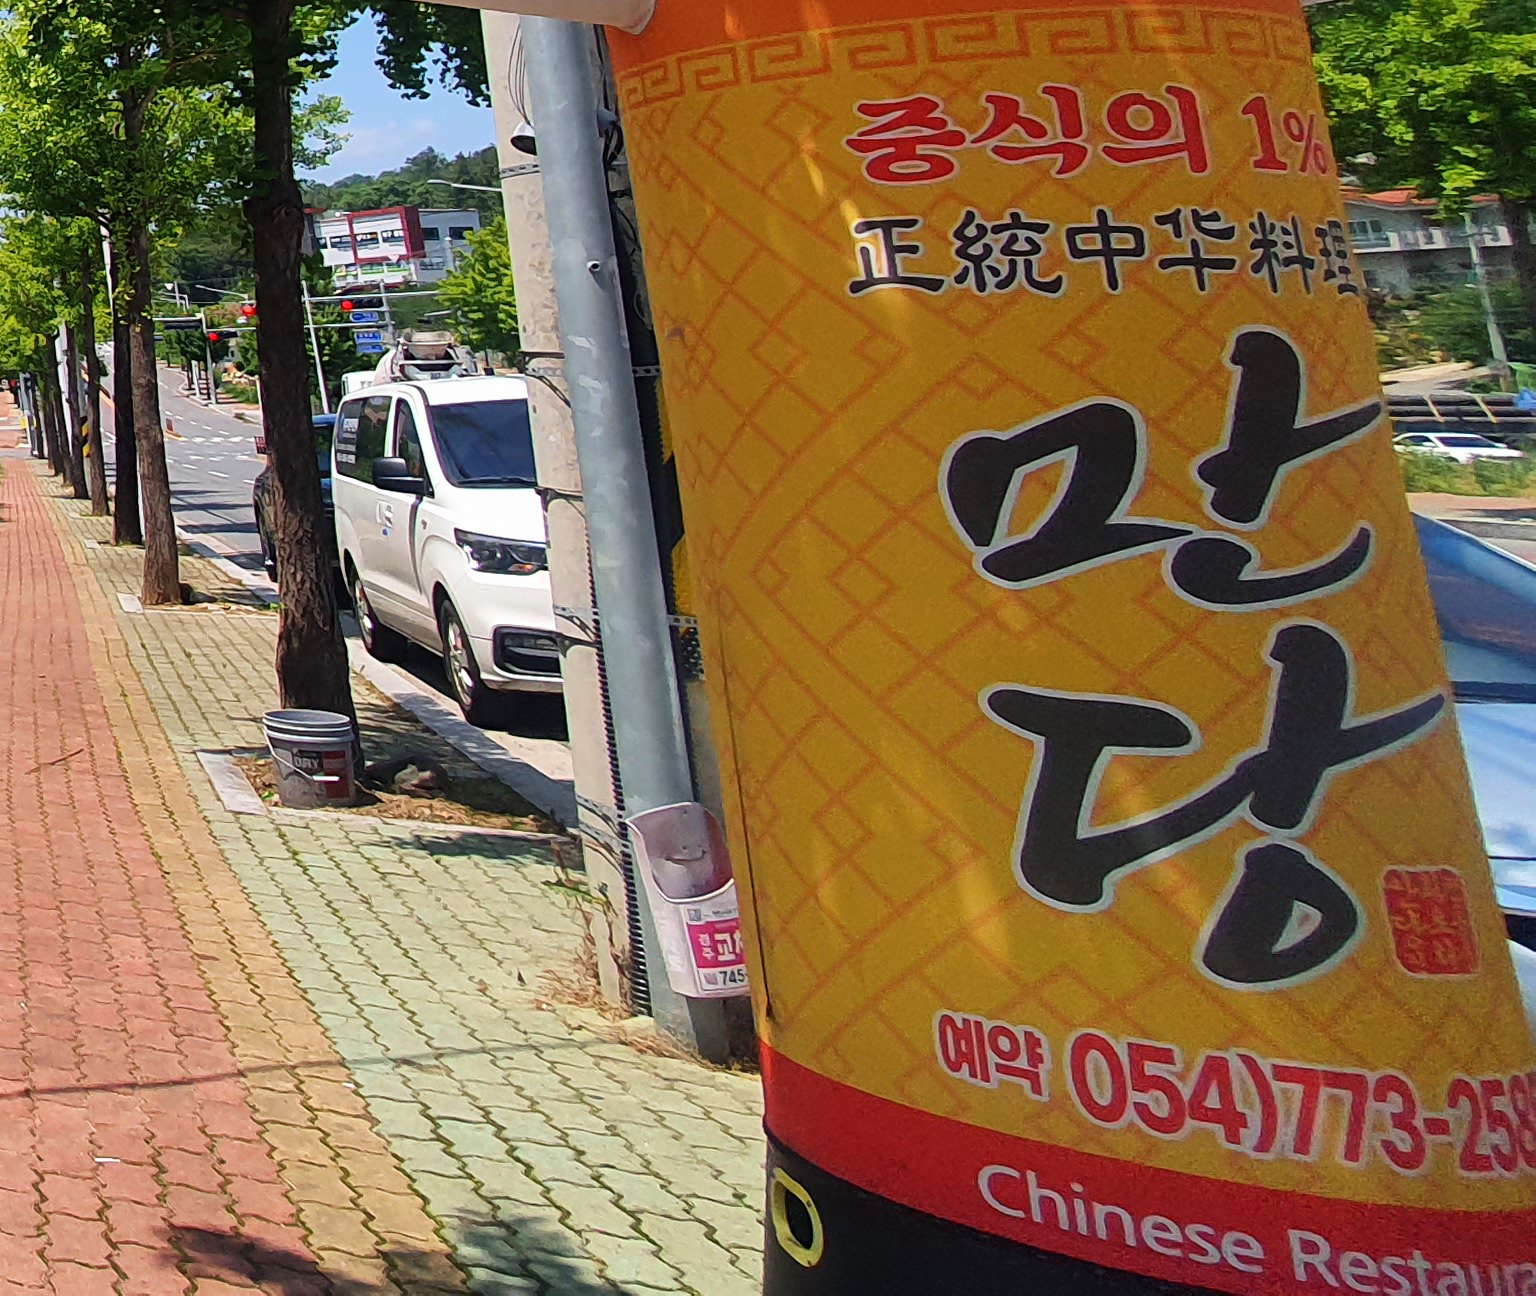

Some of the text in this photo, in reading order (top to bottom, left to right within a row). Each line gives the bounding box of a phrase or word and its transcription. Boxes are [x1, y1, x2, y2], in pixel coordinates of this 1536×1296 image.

[846, 85, 1327, 183] 중식의 1%
[938, 1015, 1044, 1098] 예약
[977, 1165, 1266, 1274] Chinese
